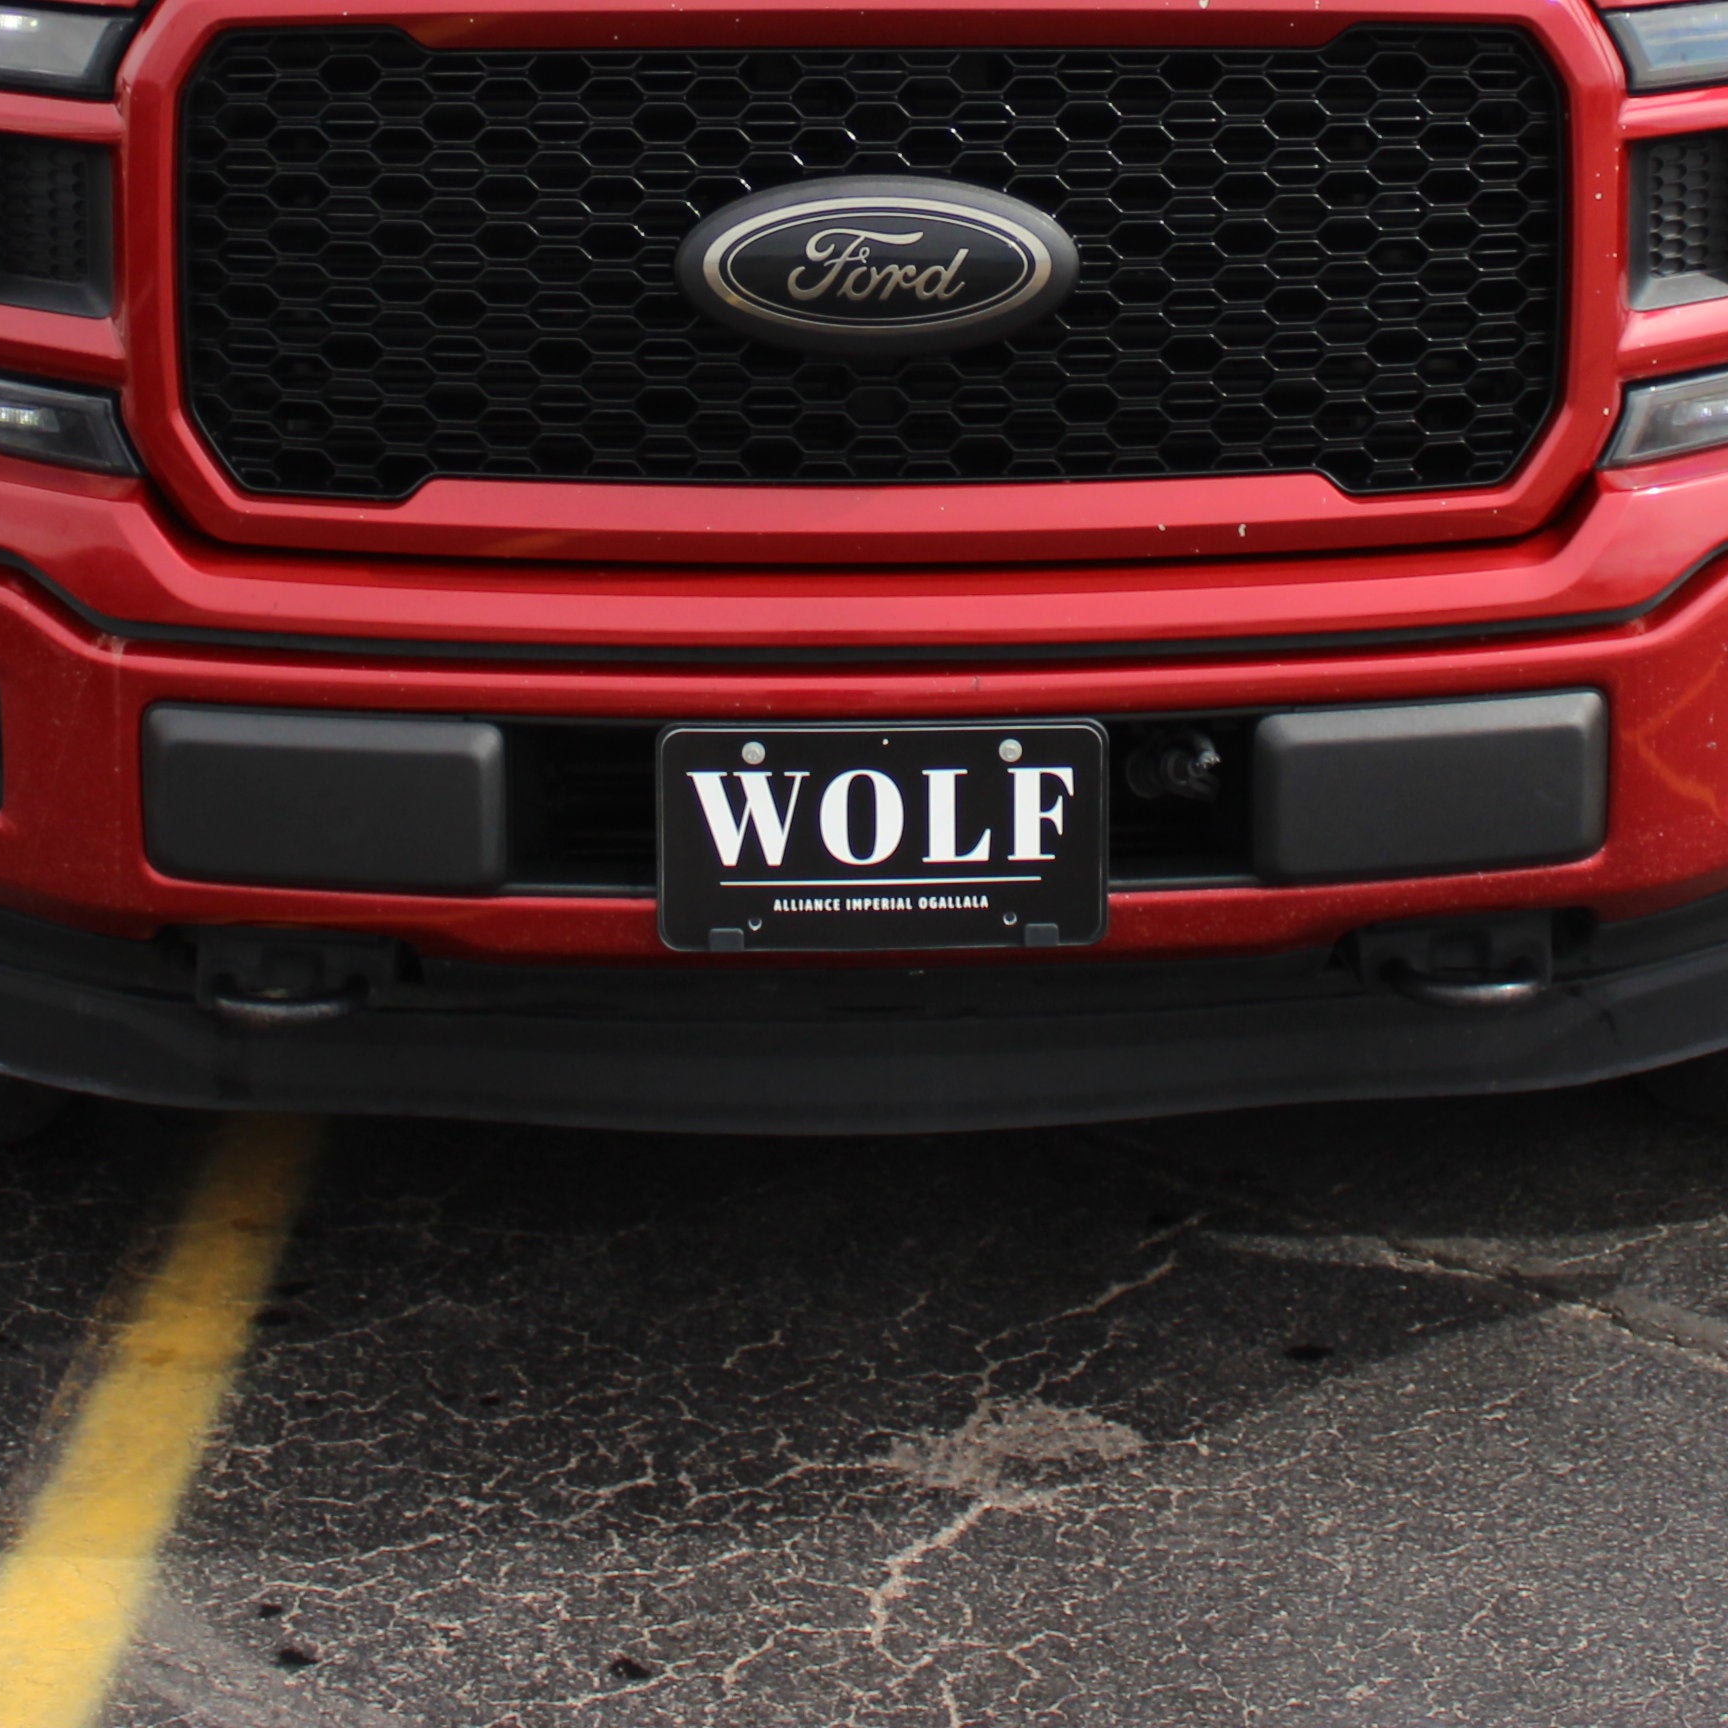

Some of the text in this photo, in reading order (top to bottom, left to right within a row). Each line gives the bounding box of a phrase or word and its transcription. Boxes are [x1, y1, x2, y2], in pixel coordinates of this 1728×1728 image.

[787, 227, 970, 301] Ford
[686, 767, 1074, 867] WOLF
[772, 894, 989, 912] ALLIANCE IMPERIAL OGALLALA
